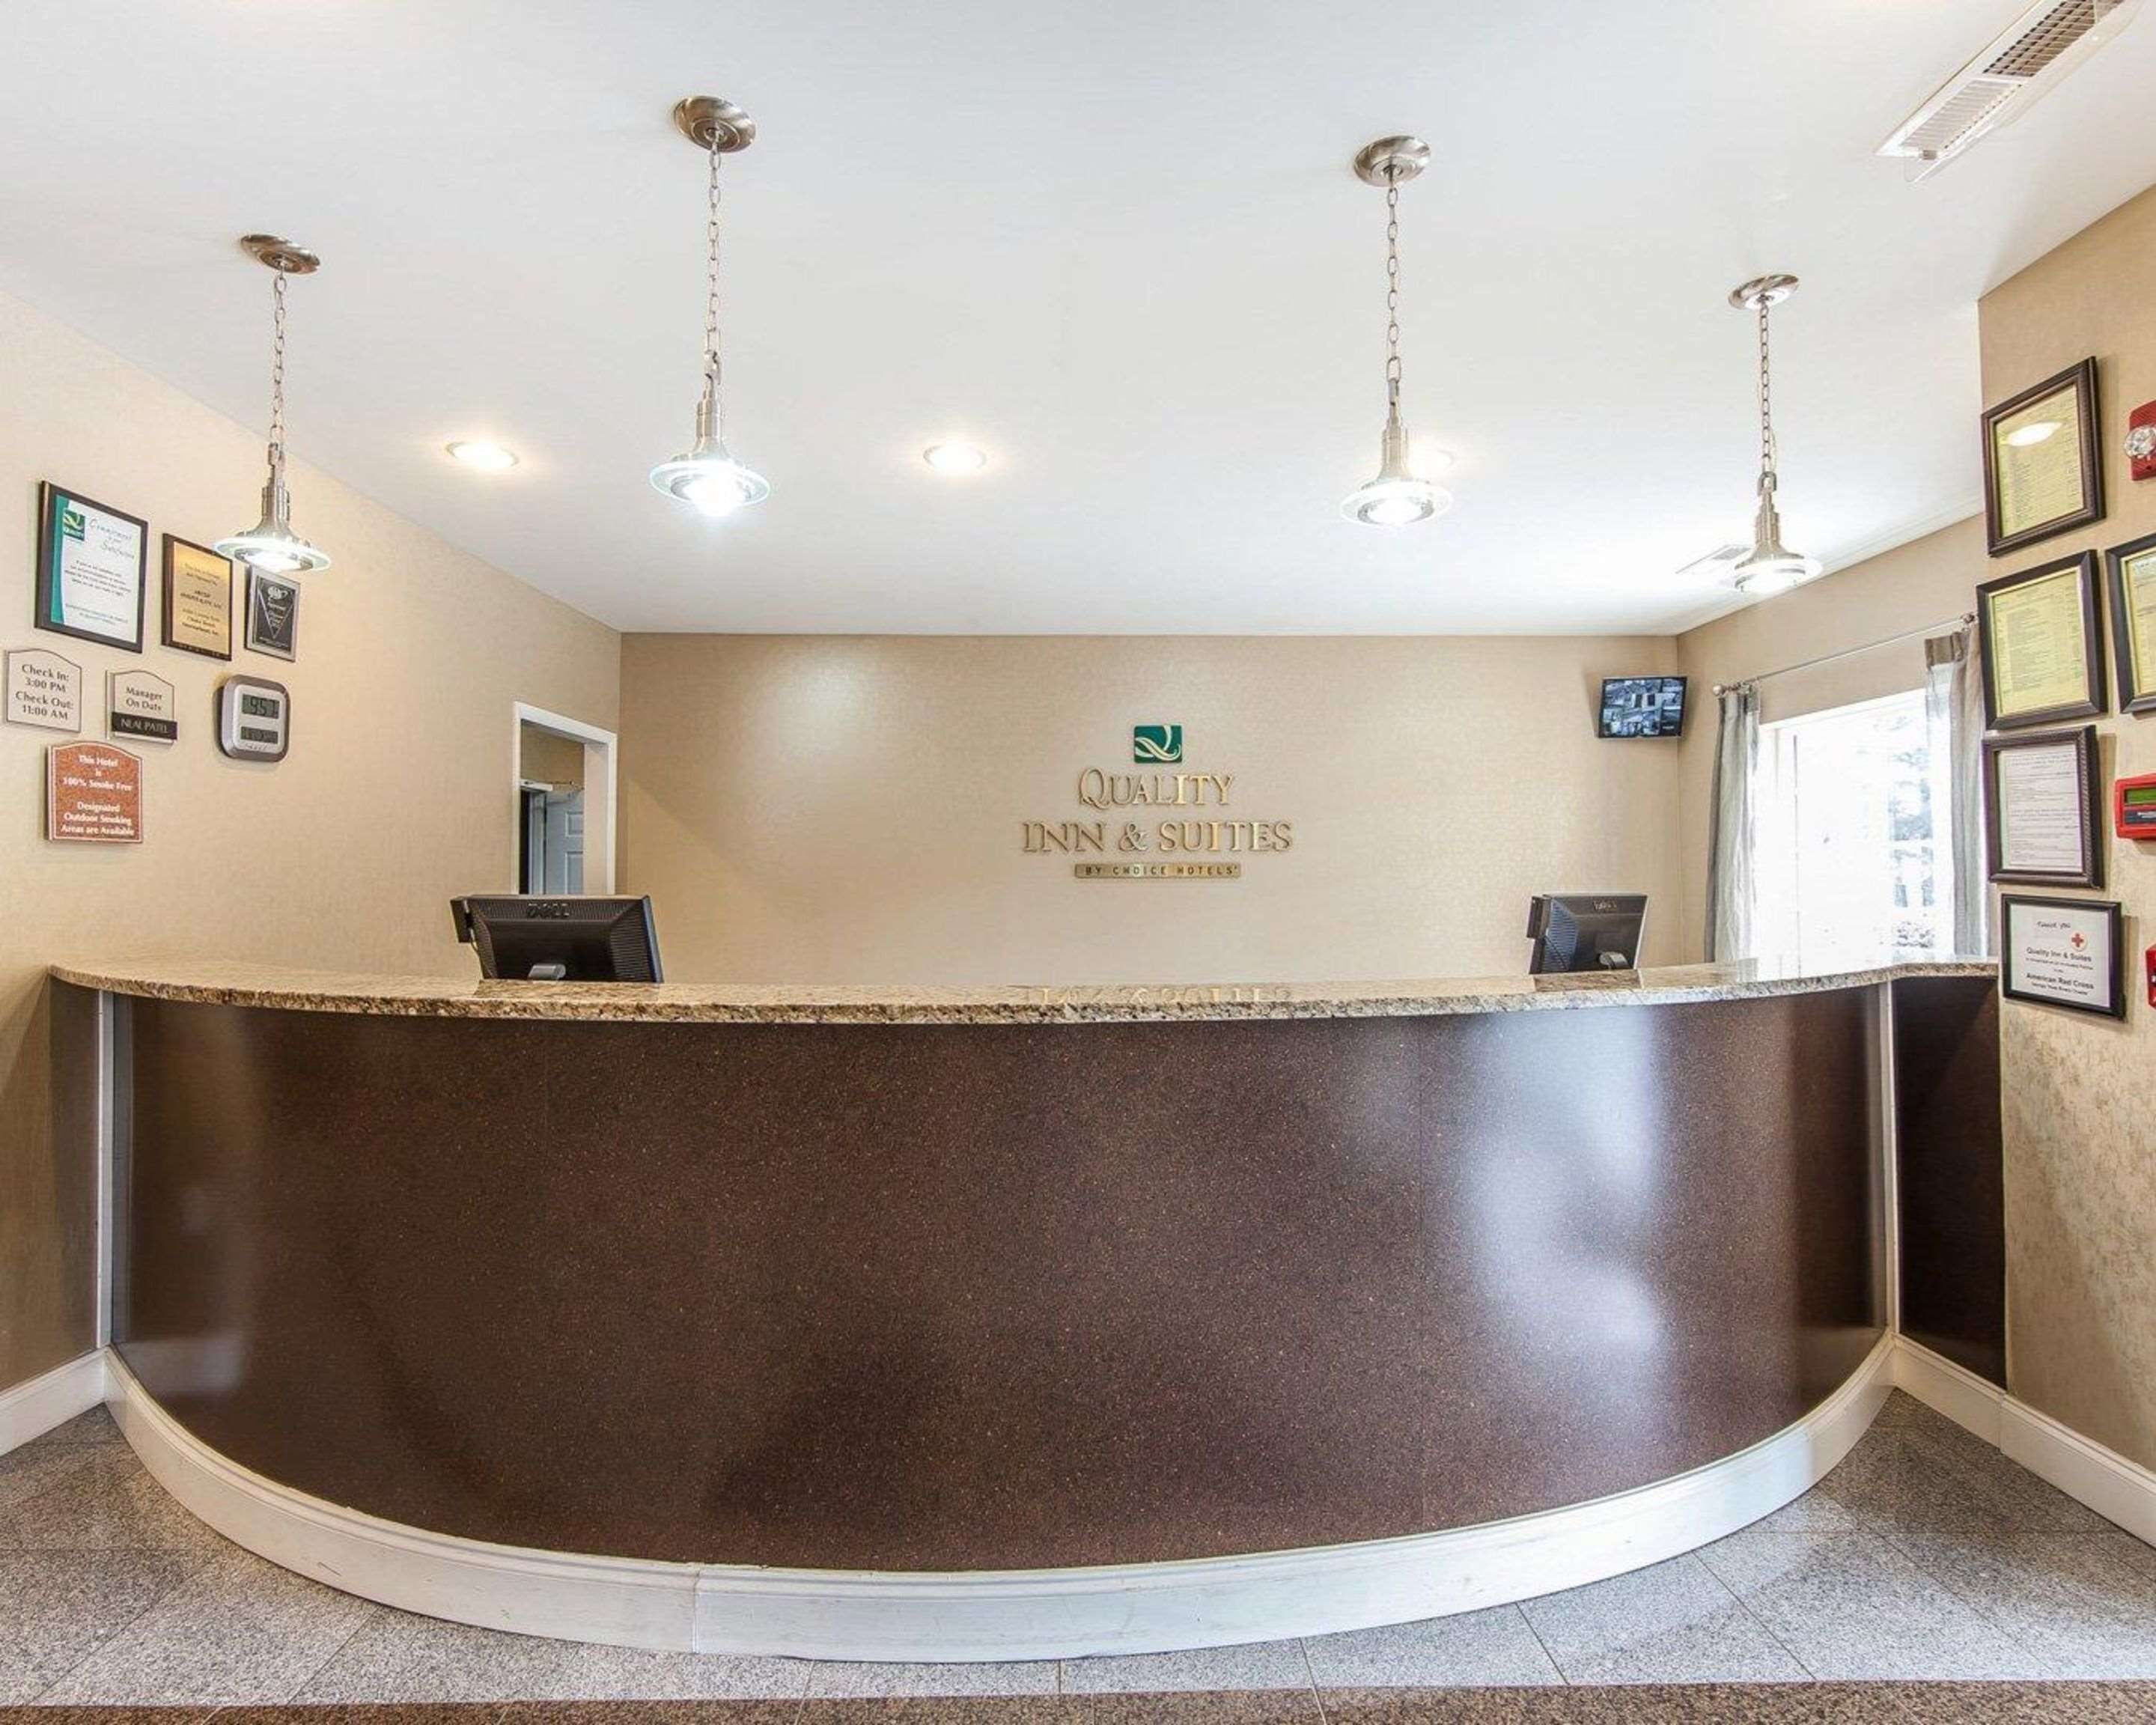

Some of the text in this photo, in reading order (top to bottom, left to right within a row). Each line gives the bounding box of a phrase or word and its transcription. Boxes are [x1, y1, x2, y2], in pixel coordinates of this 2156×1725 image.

[22, 663, 70, 681] Check In:
[25, 676, 67, 693] 3:00 PM
[15, 690, 48, 705] Check
[126, 686, 162, 701] Manager
[126, 697, 140, 708] On
[22, 704, 68, 720] 11:00 AM
[96, 757, 119, 767] Hotel
[1078, 767, 1234, 810] QUALITY
[77, 801, 121, 813] Designated
[64, 811, 99, 823] Outdoor
[61, 824, 135, 836] Areas are Available
[1023, 821, 1294, 853] INN & SUITES
[1085, 863, 1103, 875] BY
[1112, 863, 1167, 875] CHOICE
[2026, 946, 2050, 958] Quality
[2070, 953, 2092, 962] Suites
[2026, 973, 2057, 983] American
[2073, 979, 2095, 989] Cross
